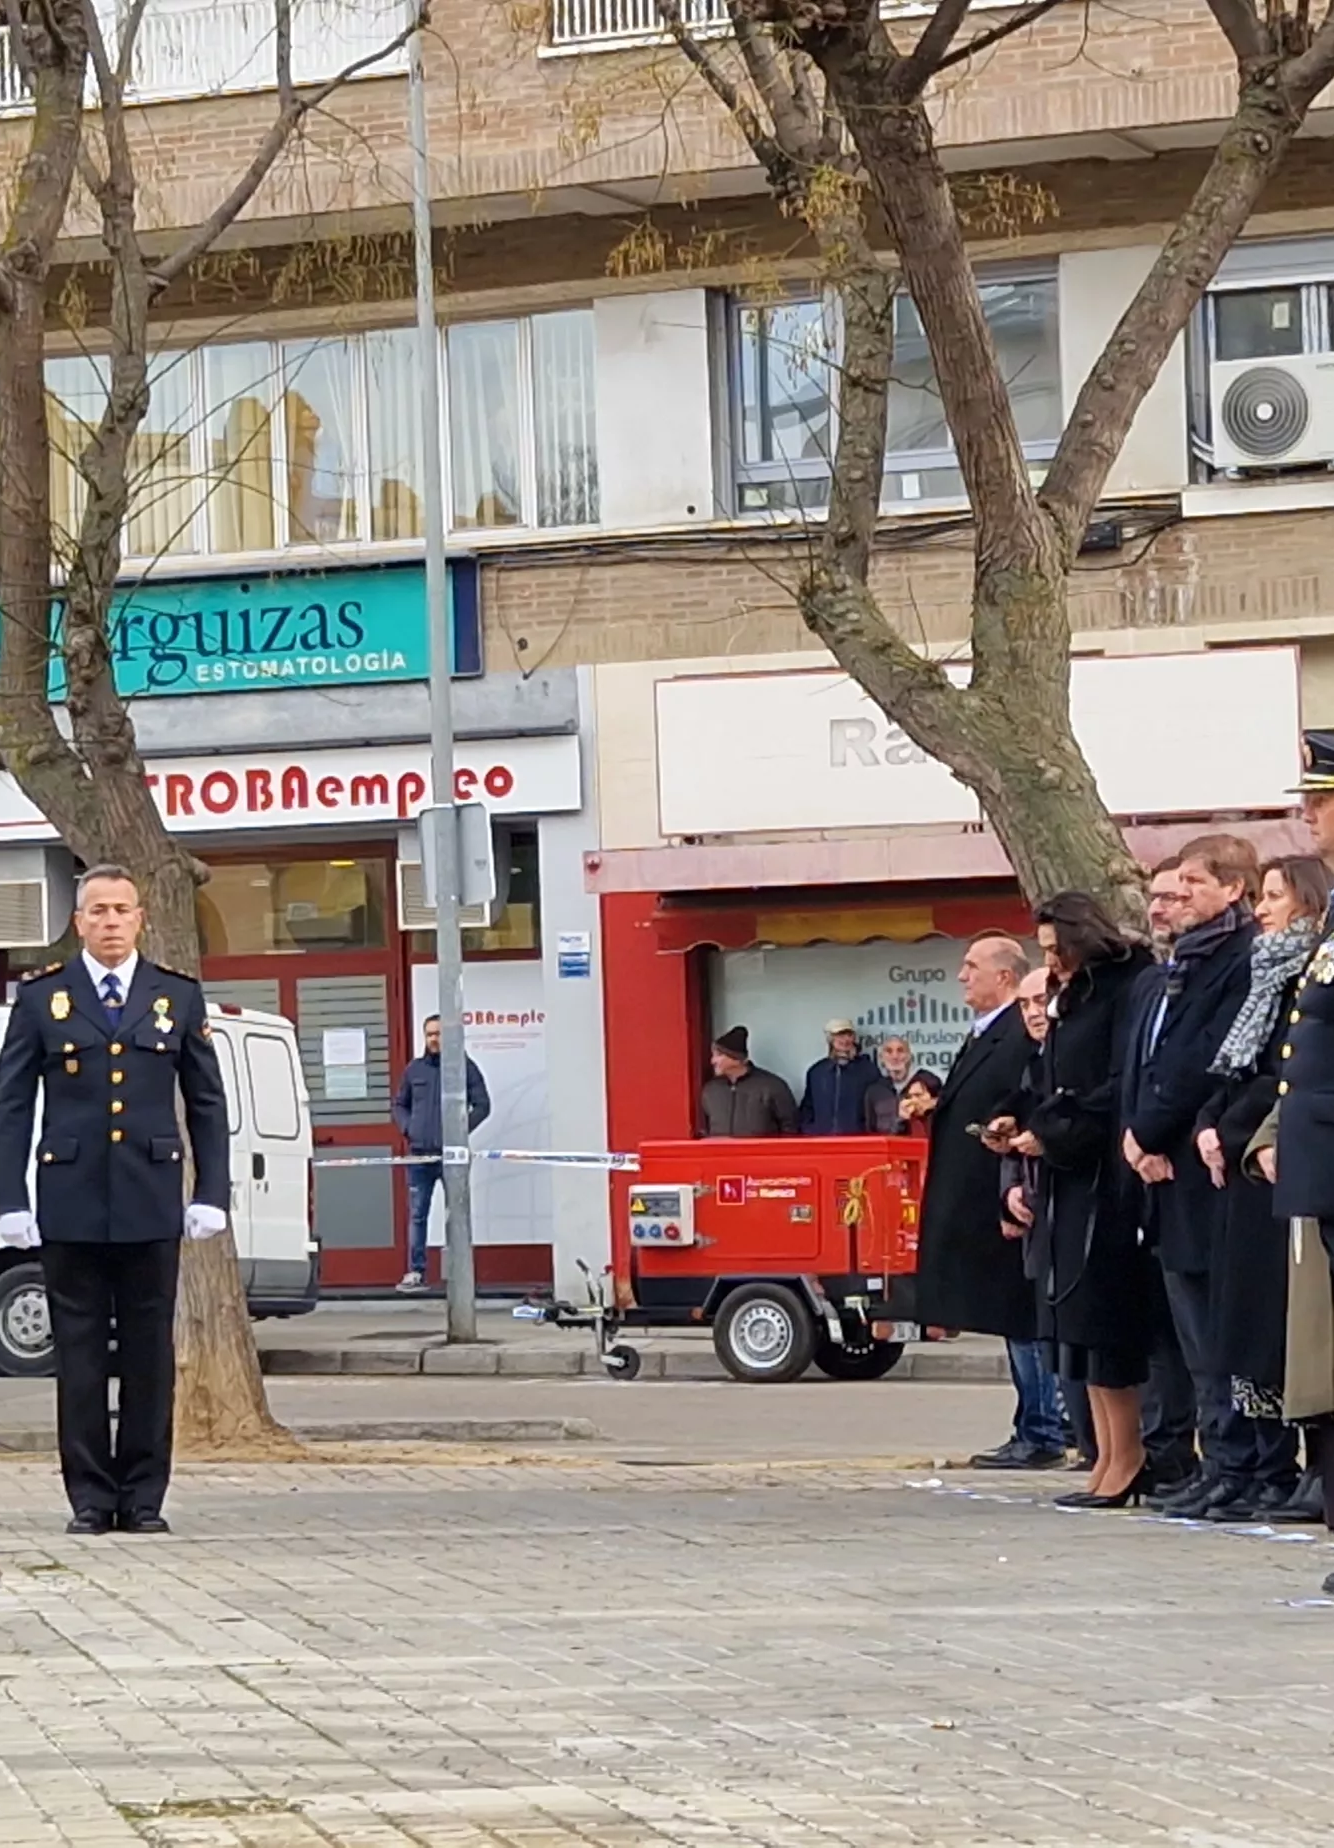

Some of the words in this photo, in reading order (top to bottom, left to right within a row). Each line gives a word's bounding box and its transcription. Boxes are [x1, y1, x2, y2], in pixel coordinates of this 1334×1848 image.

[49, 583, 364, 686] rguizas
[829, 717, 928, 768] Ra
[143, 766, 514, 818] ROBAempeo
[888, 965, 946, 985] Grupo
[461, 1008, 546, 1028] OBAemple
